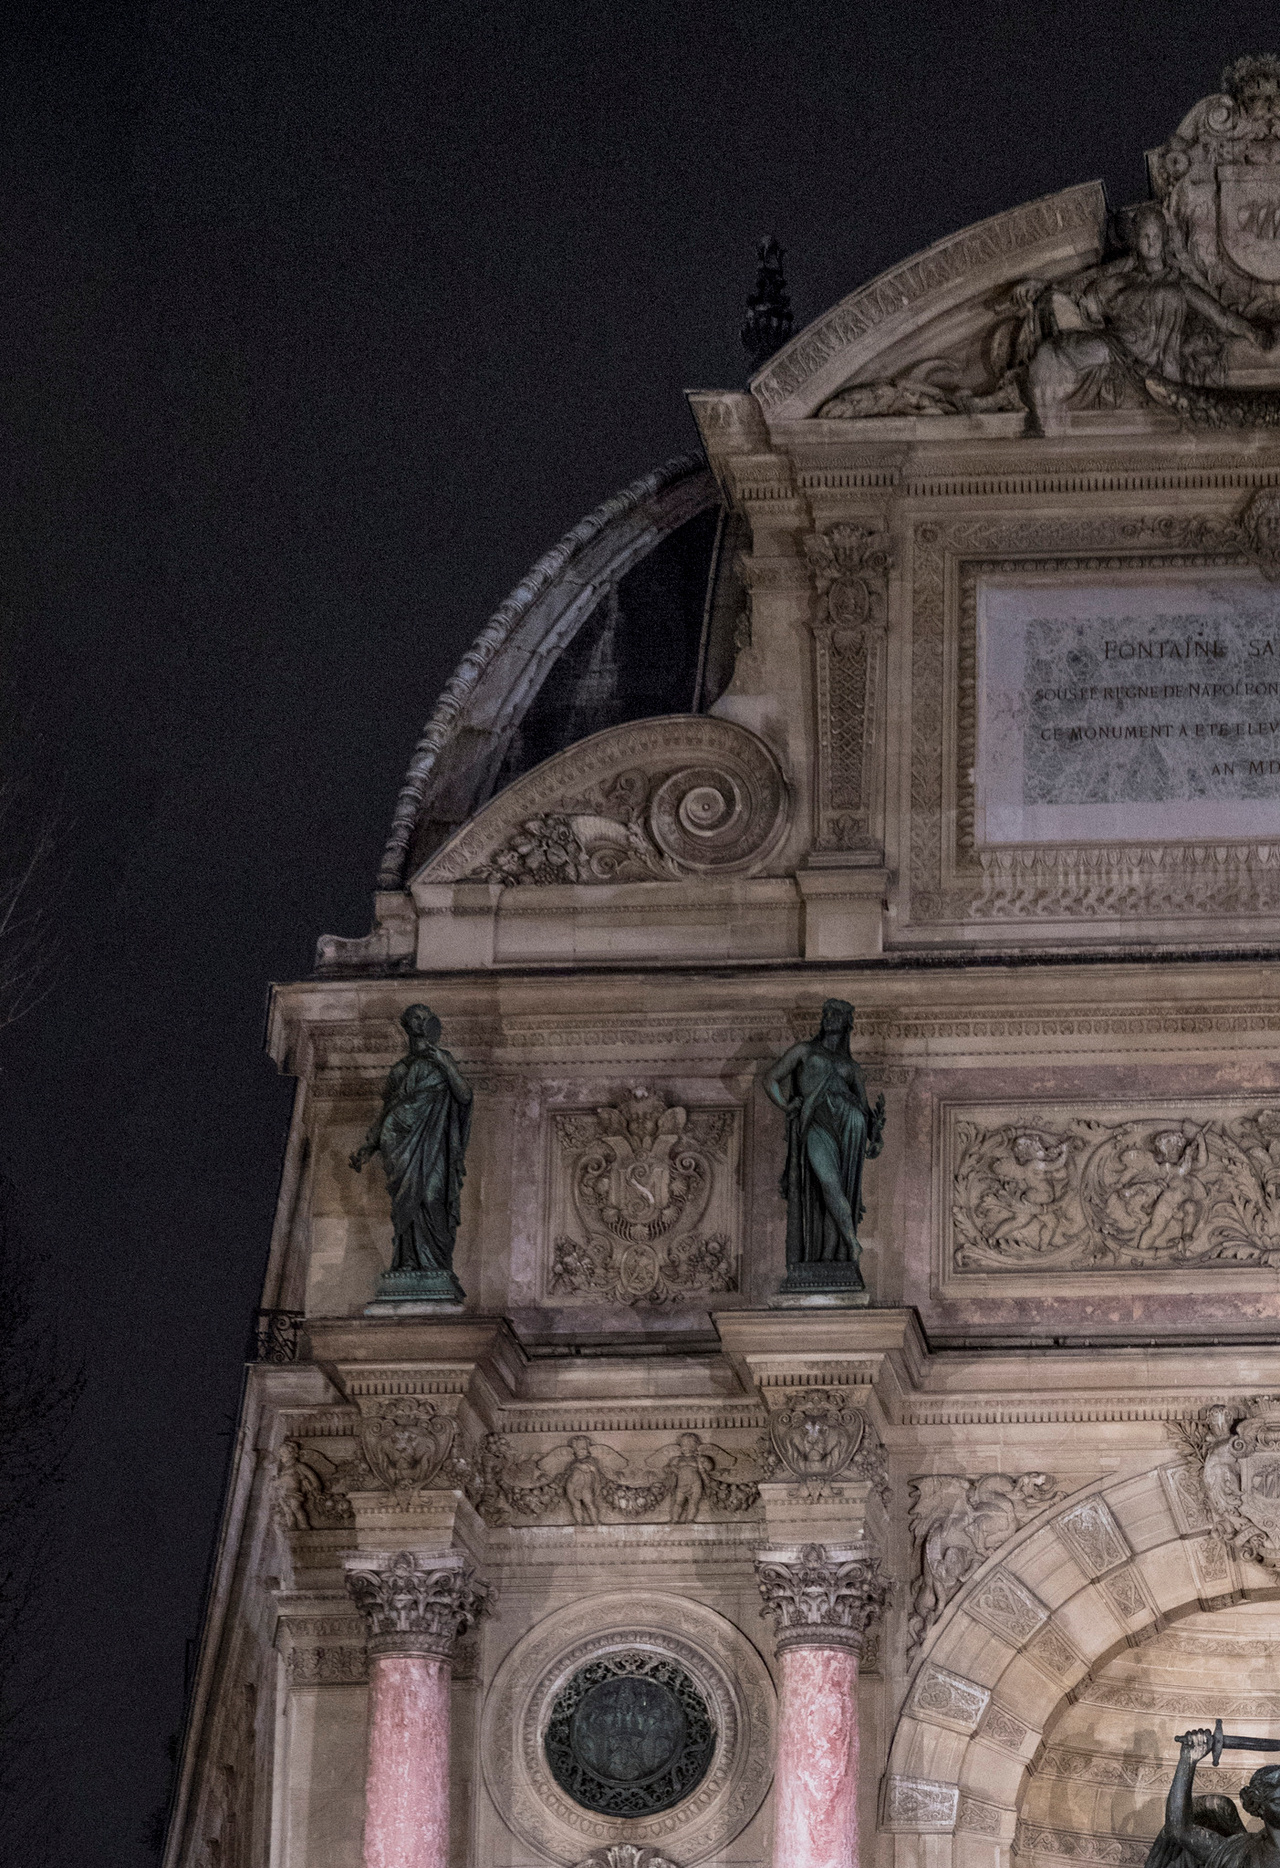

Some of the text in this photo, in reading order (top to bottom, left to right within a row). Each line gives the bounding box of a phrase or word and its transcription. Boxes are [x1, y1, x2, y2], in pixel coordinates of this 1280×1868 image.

[1163, 683, 1183, 698] DE
[1041, 727, 1063, 741] CE
[1069, 724, 1174, 741] MONUMENT
[1212, 762, 1234, 776] AN
